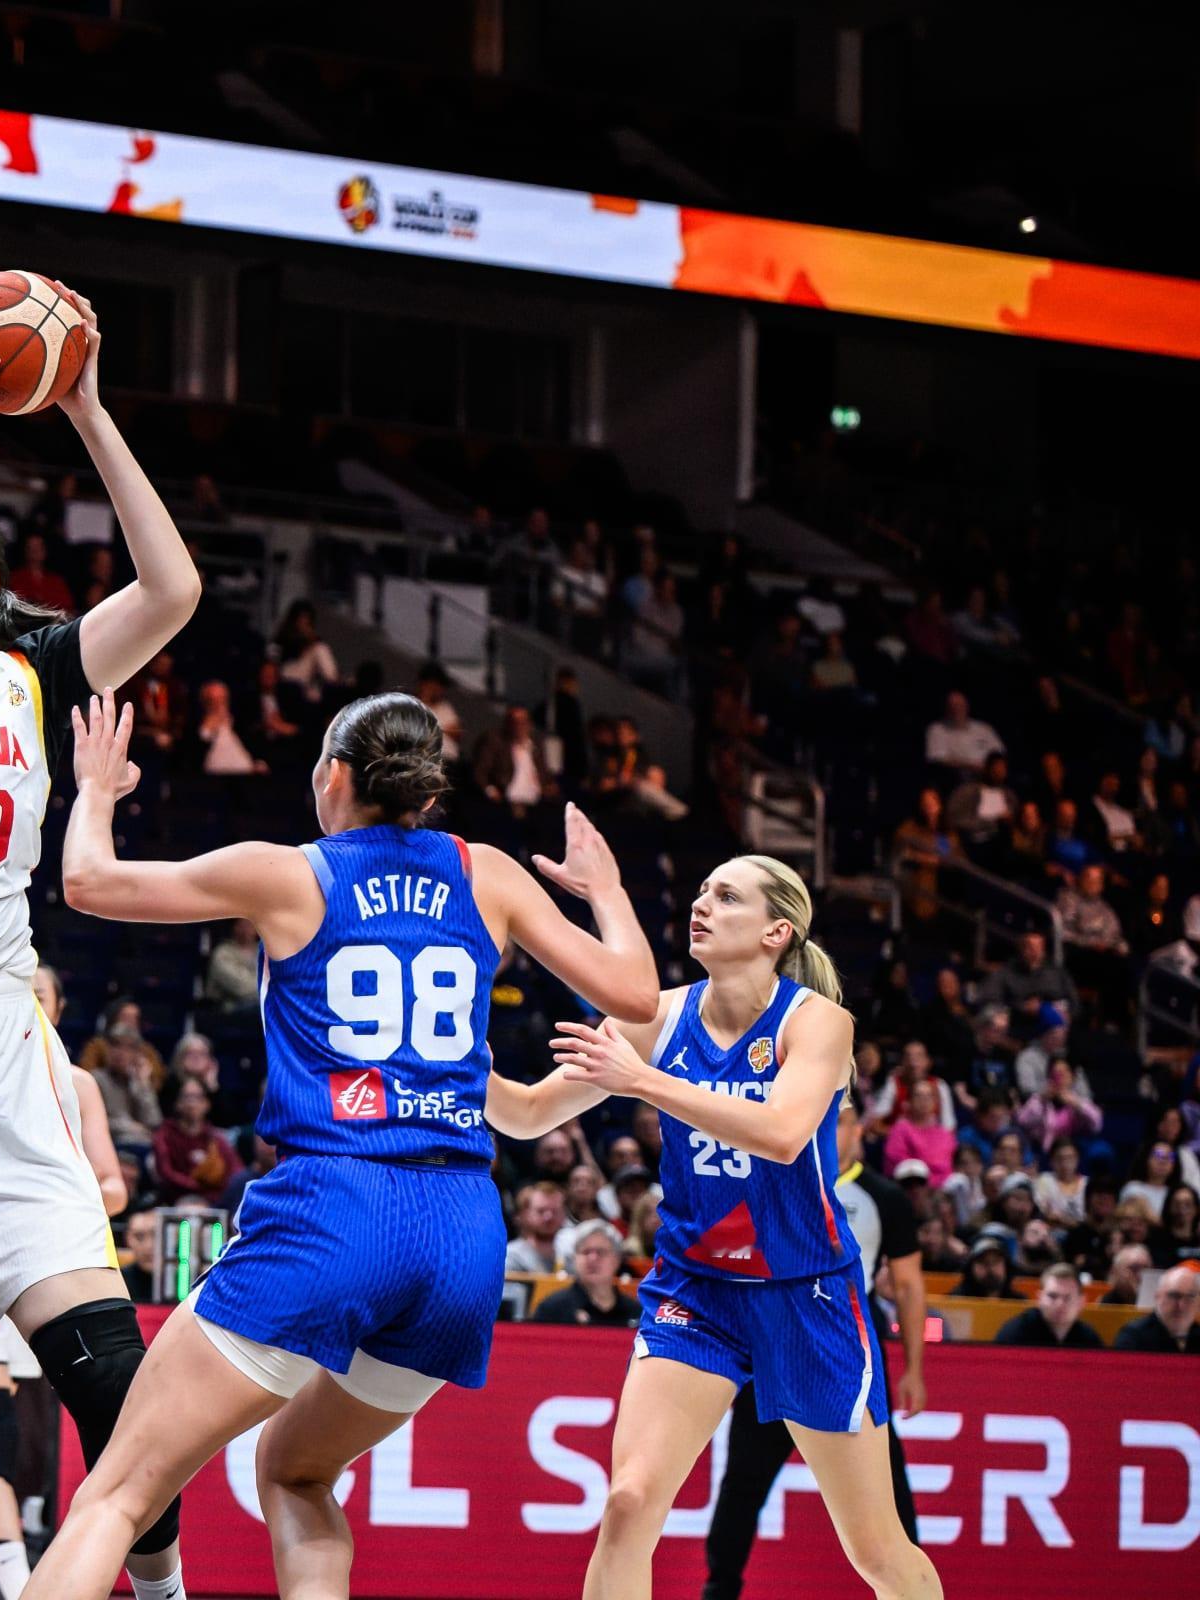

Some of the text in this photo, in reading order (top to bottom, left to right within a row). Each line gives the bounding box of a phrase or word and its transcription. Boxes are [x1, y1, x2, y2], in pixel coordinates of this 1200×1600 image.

[353, 874, 450, 921] ASTIER
[326, 945, 477, 1062] 98
[688, 1131, 752, 1179] 23
[520, 1395, 1075, 1549] SUER
